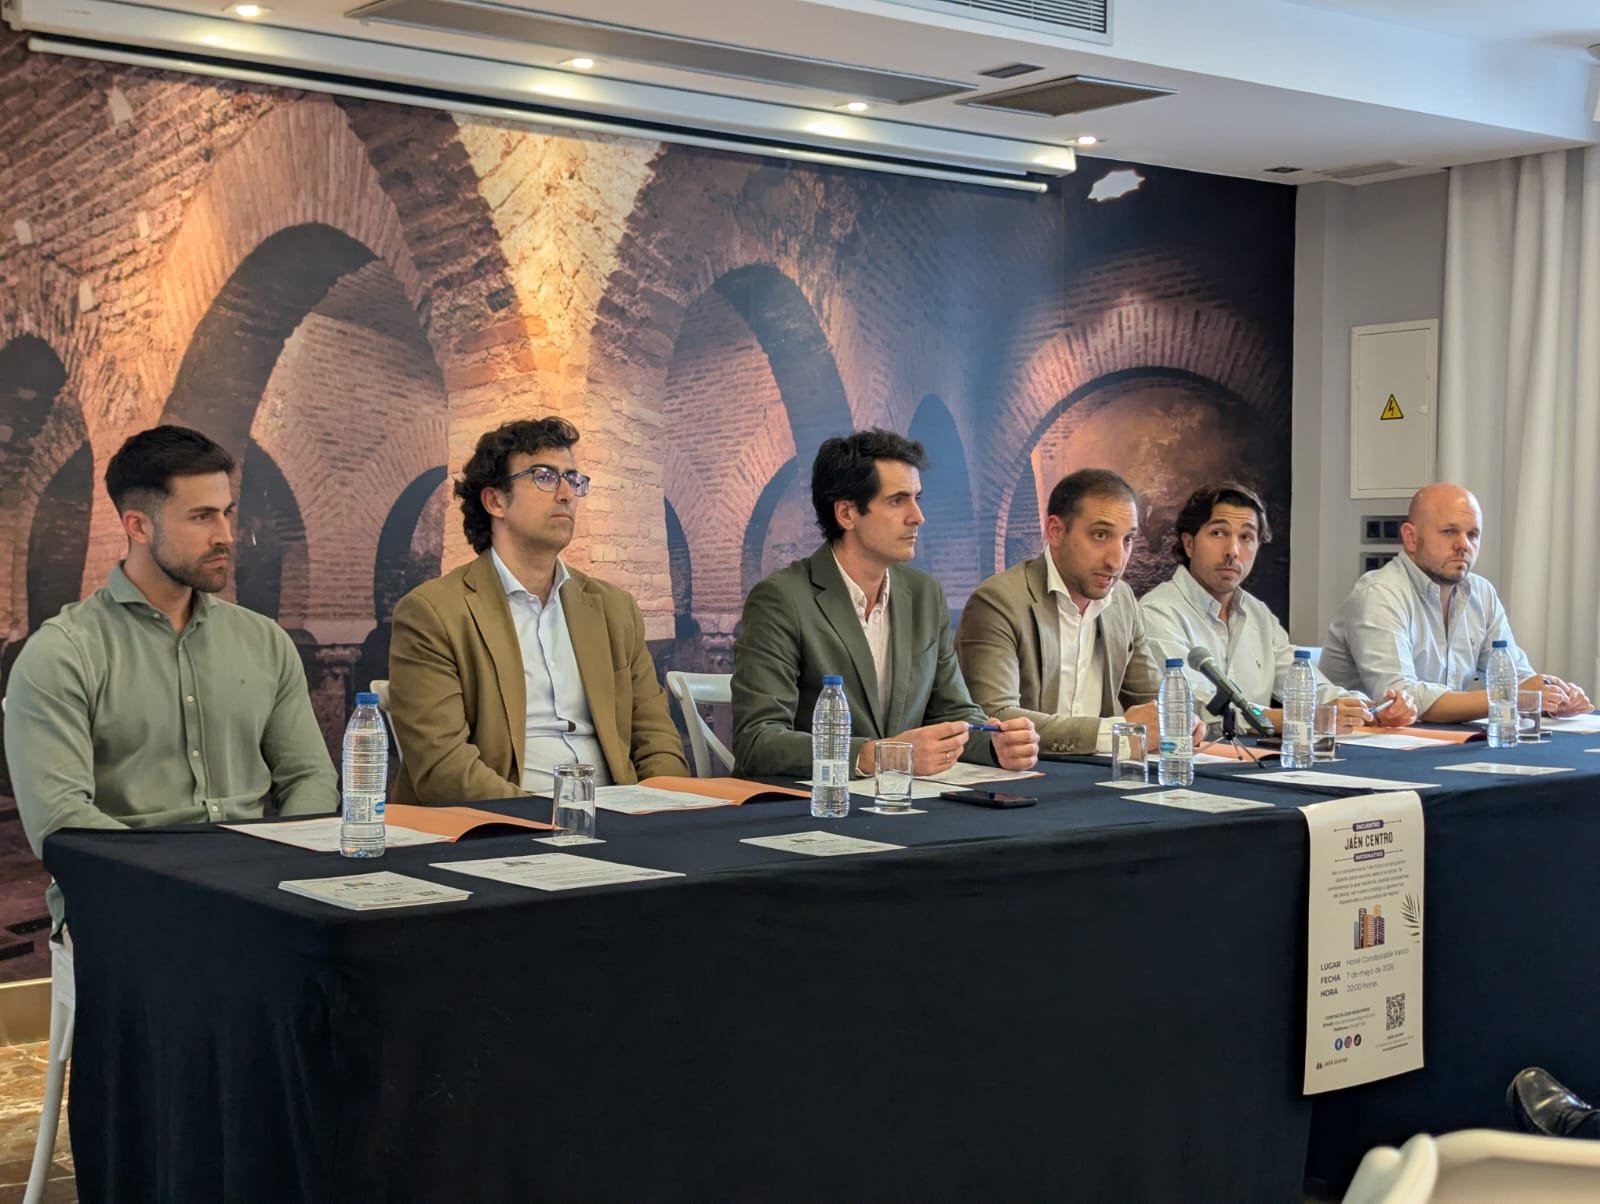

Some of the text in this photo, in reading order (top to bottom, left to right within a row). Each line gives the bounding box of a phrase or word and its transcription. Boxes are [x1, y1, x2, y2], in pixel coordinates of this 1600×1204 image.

[1344, 832, 1393, 850] JAÉN CENTRO
[1320, 961, 1341, 971] LUGAR
[1320, 974, 1341, 985] FECHA
[1359, 969, 1374, 978] mayo
[1320, 988, 1339, 998] HORA
[1363, 981, 1378, 990] horas
